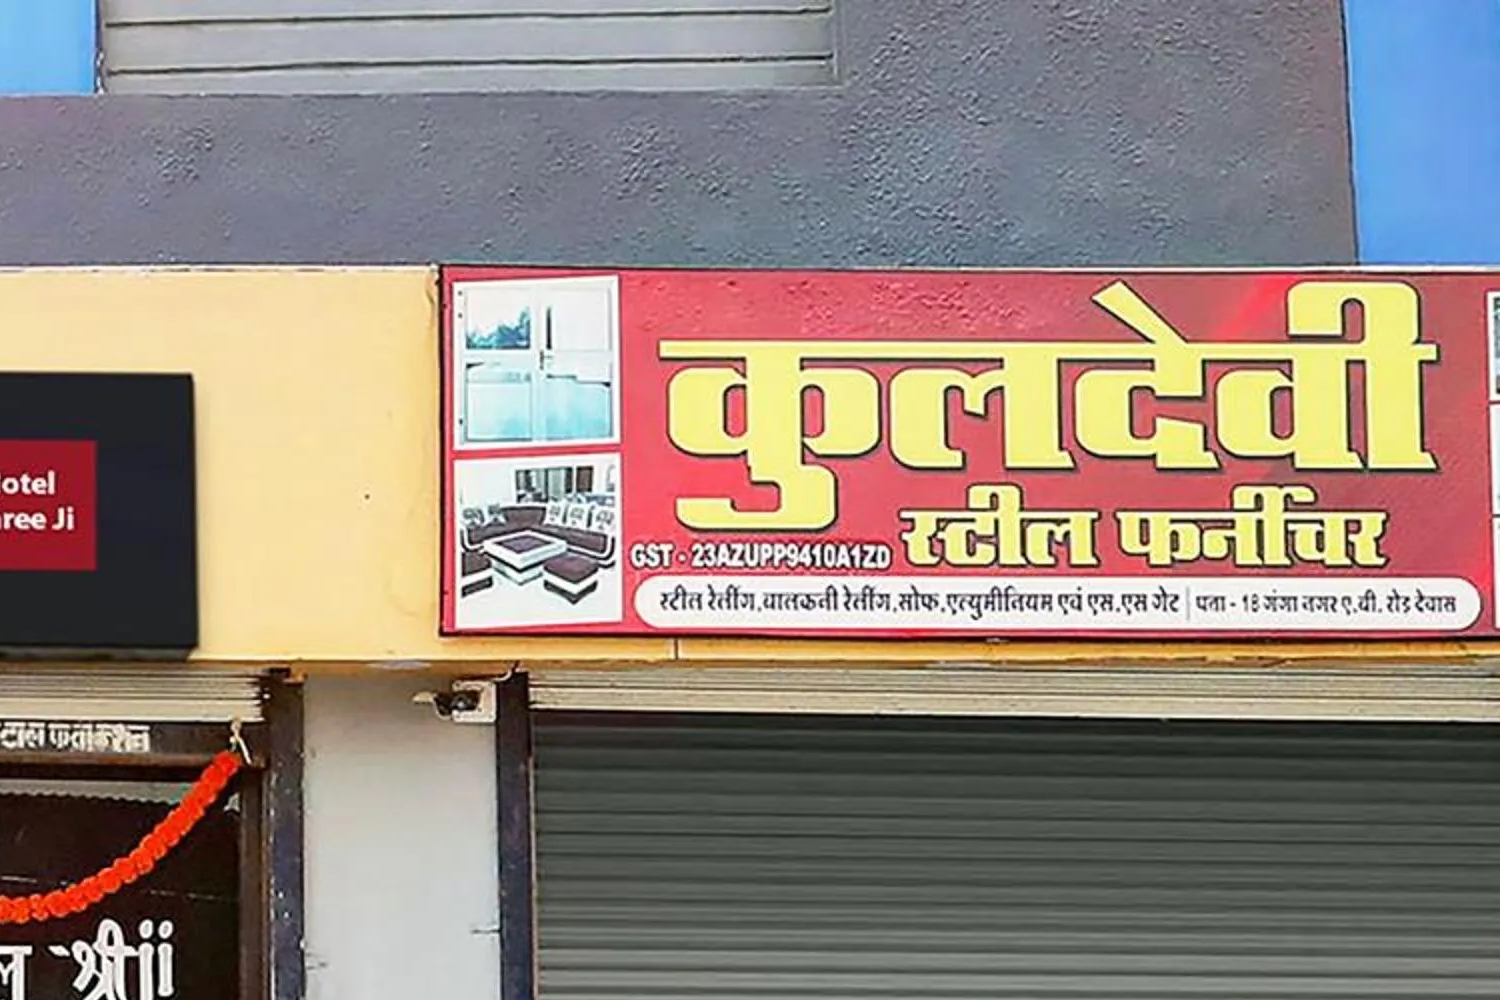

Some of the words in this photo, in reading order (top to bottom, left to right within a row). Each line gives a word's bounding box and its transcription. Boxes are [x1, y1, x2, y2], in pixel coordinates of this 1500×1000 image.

[658, 279, 1440, 532] कुलदेवी
[51, 506, 74, 531] Ji
[900, 485, 1100, 568] स्टील
[1116, 485, 1390, 568] फर्नीचर
[631, 543, 674, 568] GST
